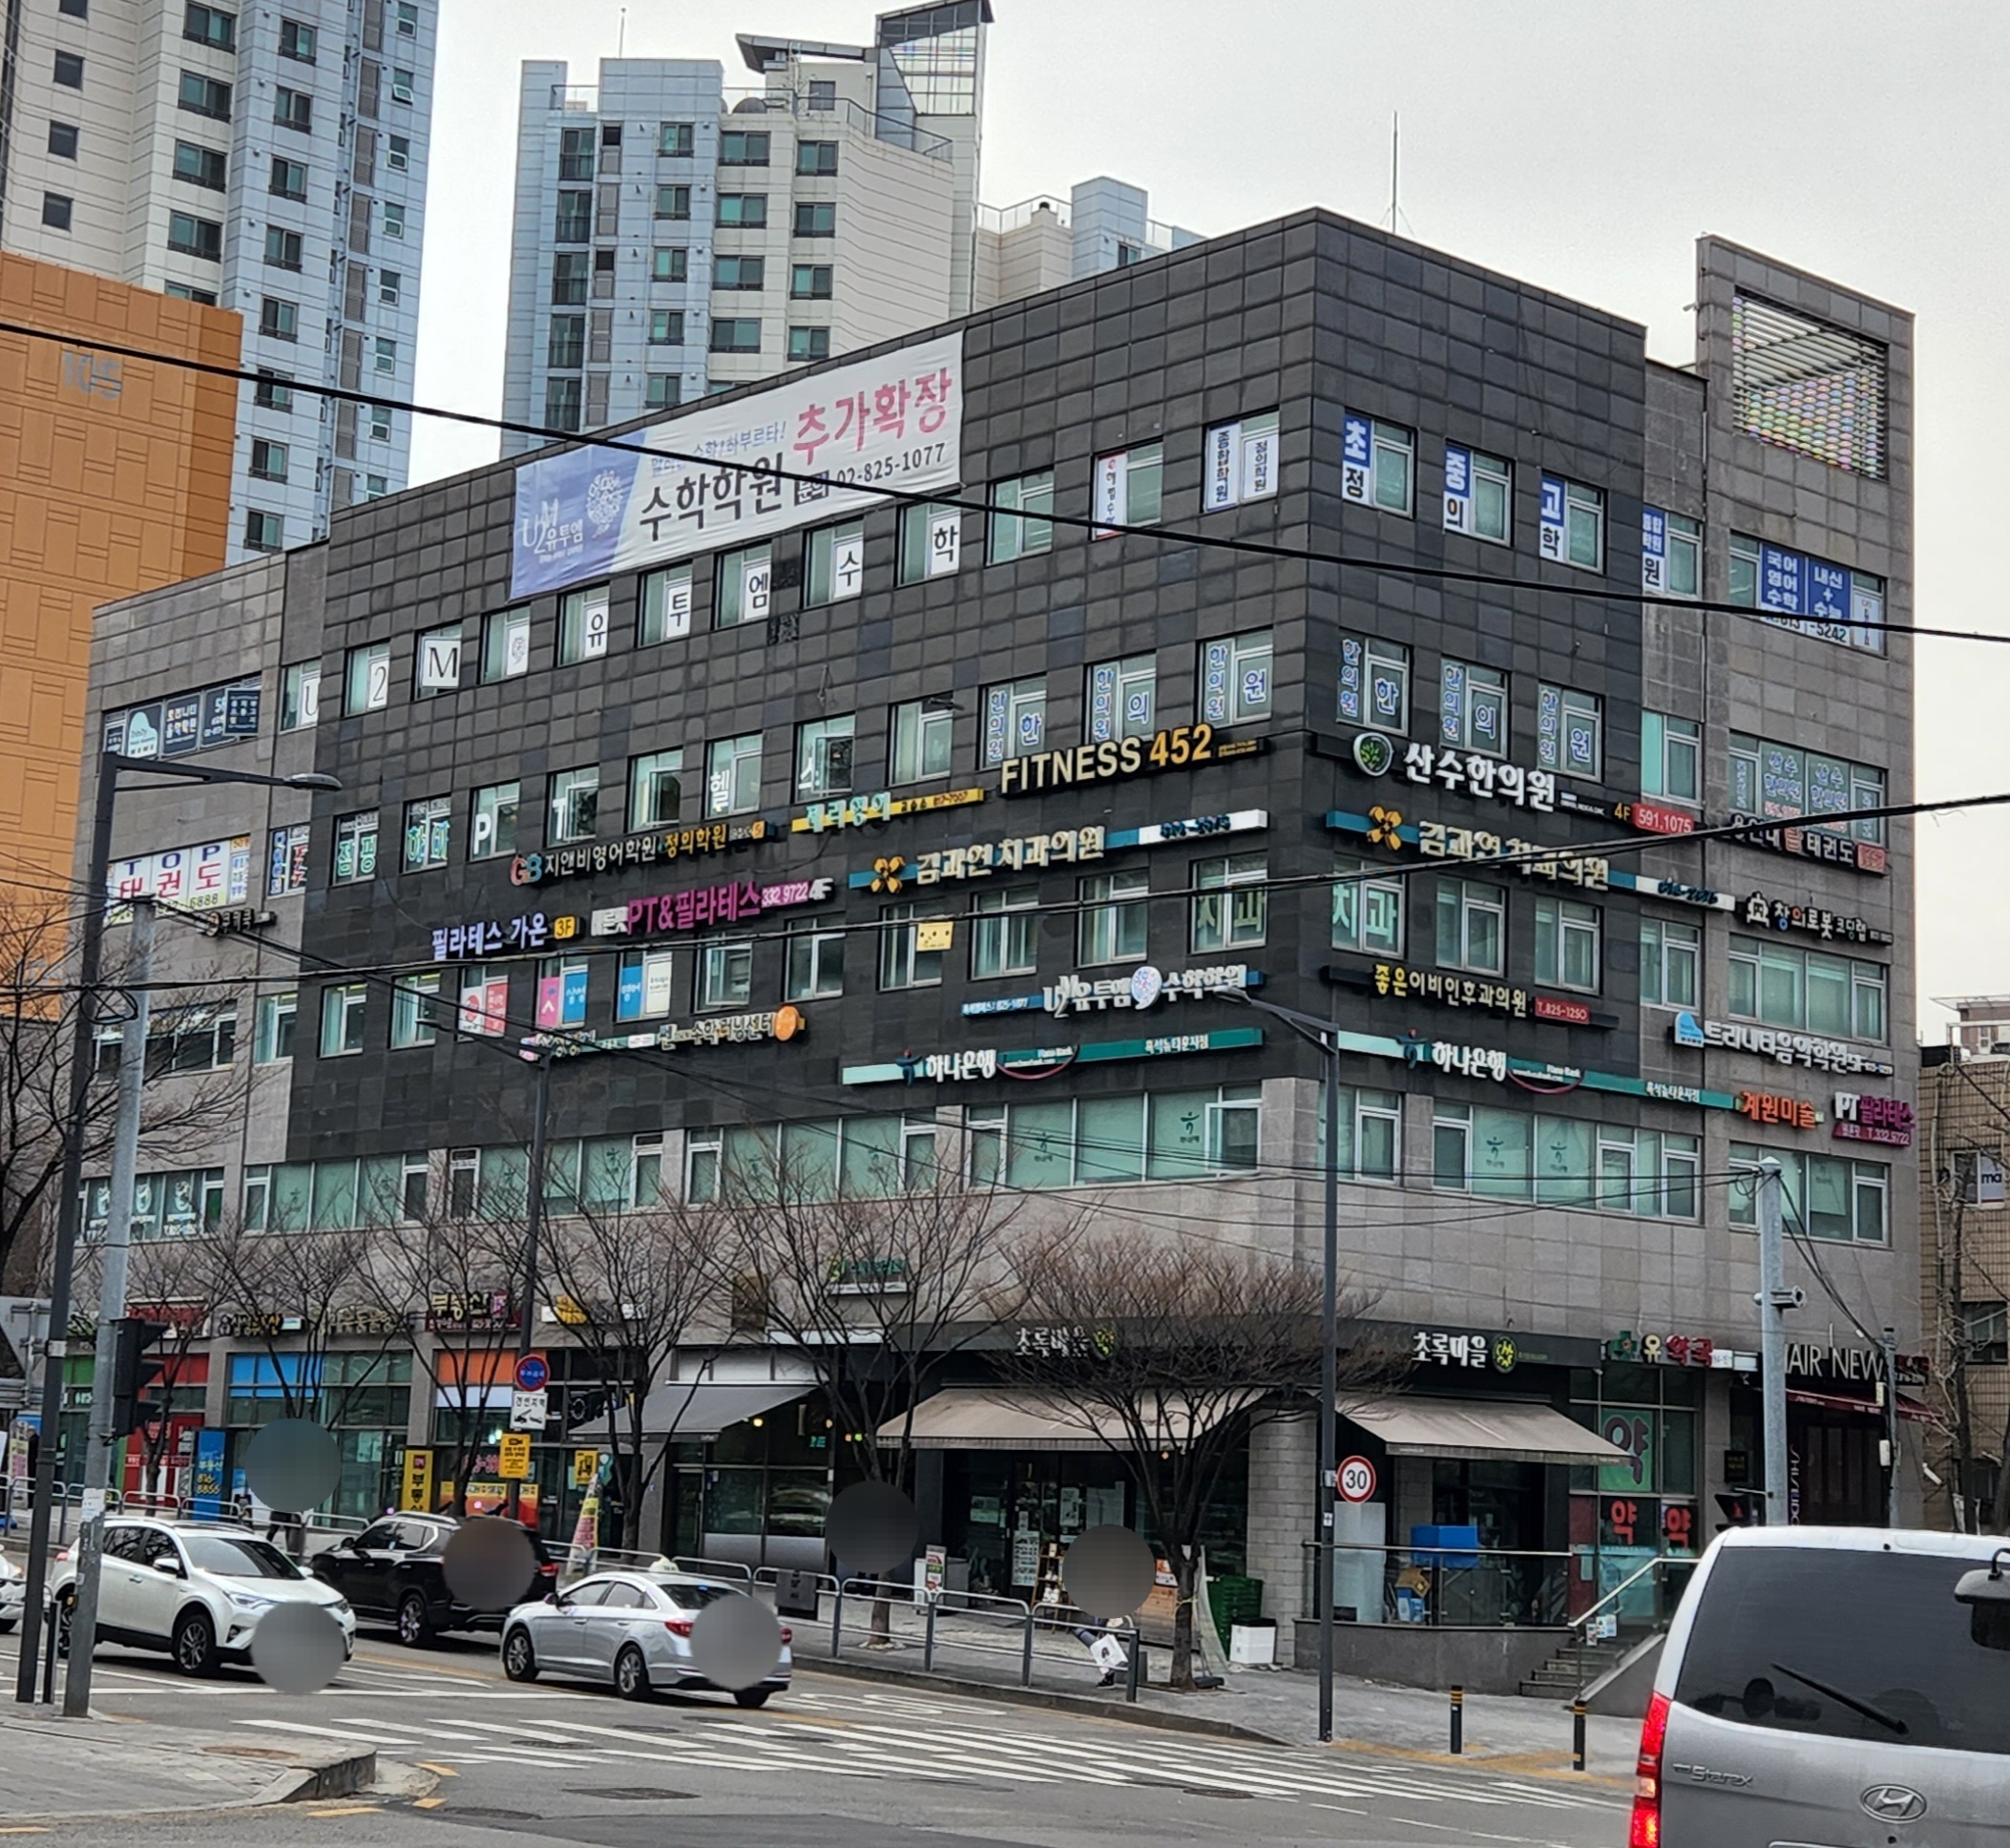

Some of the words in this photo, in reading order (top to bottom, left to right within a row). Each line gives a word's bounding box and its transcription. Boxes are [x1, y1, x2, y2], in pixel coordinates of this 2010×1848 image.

[793, 367, 953, 467] 추가확장
[836, 442, 947, 488] 02-825-1077
[639, 452, 784, 541] 수학학원
[1767, 550, 1798, 573] 국어
[1767, 569, 1798, 592] 영어
[1812, 566, 1844, 591] 내신
[1766, 588, 1798, 612] 수학
[1206, 644, 1228, 722] 한의원
[1340, 638, 1362, 718] 한의원
[1441, 664, 1463, 742] 한의원
[1538, 689, 1559, 764] 한의원
[1001, 735, 1142, 795] FITNESS
[1148, 723, 1213, 767] 452
[1403, 742, 1556, 812] 산수한의원
[1613, 801, 1632, 821] 4F
[1637, 811, 1693, 834] 591.1075
[544, 834, 658, 877] 지앤비영어학원
[663, 823, 728, 859] 정의학원
[1807, 831, 1854, 865] 태권도
[626, 880, 762, 935] PT&필라테스
[1331, 882, 1398, 944] 치과
[1774, 901, 1833, 940] 창의로봇
[431, 920, 503, 961] 필라테스
[510, 912, 549, 951] 가온
[1160, 964, 1247, 1001] 수학학원
[1373, 962, 1527, 1018] 좋은이비인후과의원
[925, 1048, 996, 1084] 하나은행
[1431, 1040, 1508, 1082] 하나은행
[1740, 1090, 1817, 1130] 계원미술
[1833, 1091, 1861, 1122] PT
[1412, 1332, 1489, 1369] 초록마을
[1832, 1347, 1889, 1381] NEW
[1603, 1415, 1650, 1486] 약
[1345, 1468, 1368, 1491] 30
[1610, 1500, 1639, 1545] 약
[1665, 1506, 1692, 1549] 약
